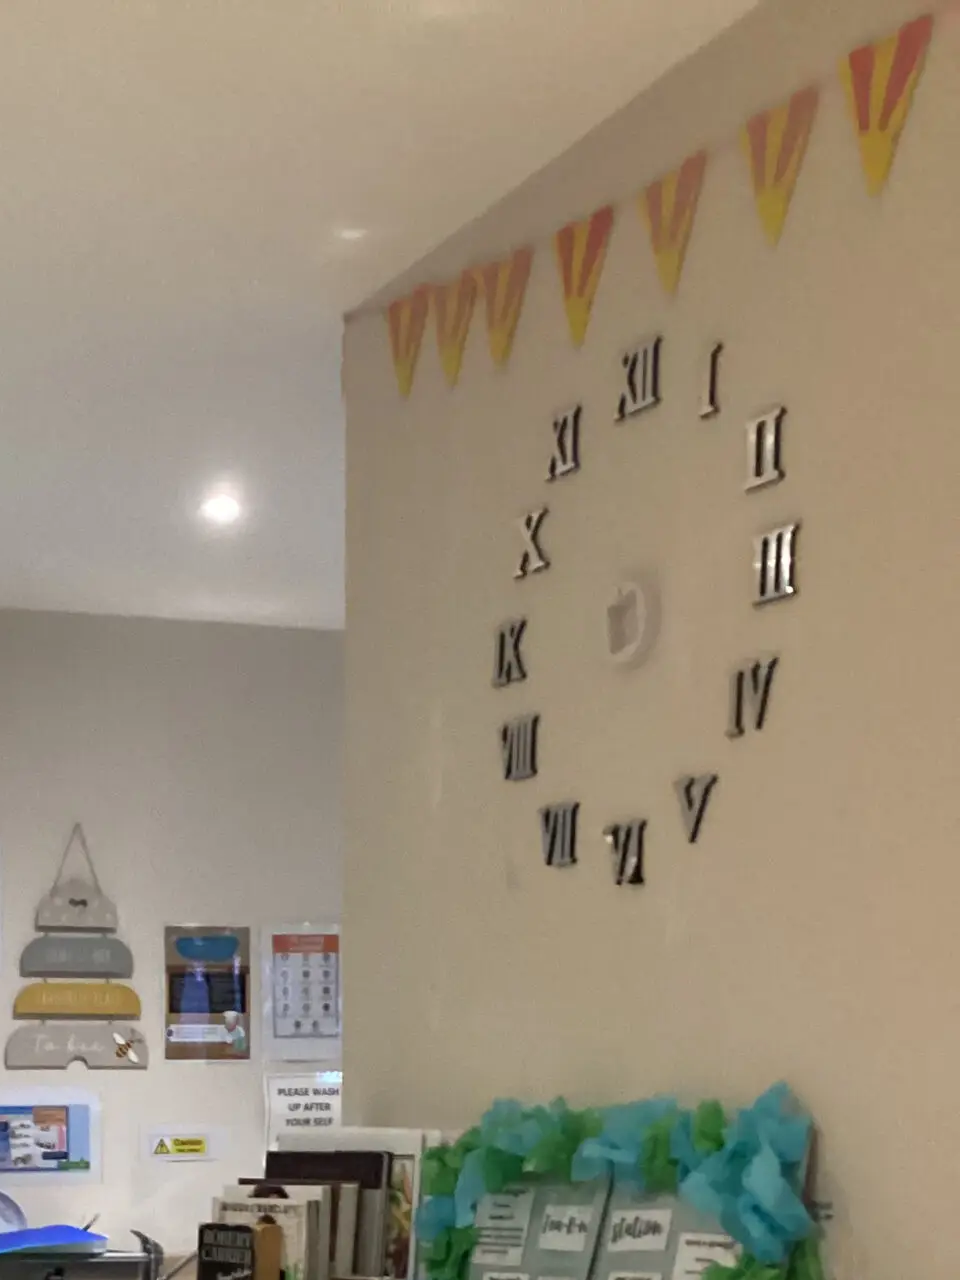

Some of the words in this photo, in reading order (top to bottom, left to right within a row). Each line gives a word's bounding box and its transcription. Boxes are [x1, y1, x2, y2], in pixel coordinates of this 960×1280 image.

[612, 334, 663, 422] XII
[699, 342, 724, 419] I
[544, 404, 583, 481] XI
[744, 406, 787, 493] II
[513, 507, 549, 580] X
[752, 521, 801, 609] III
[726, 656, 779, 739] IV
[675, 773, 718, 843] V
[603, 819, 647, 886] VI
[277, 1087, 310, 1097] PLEASE
[312, 1087, 340, 1097] WASH
[285, 1117, 311, 1127] YOUR
[313, 1116, 334, 1126] SELF
[288, 1102, 301, 1112] UP
[303, 1102, 331, 1112] AFTER
